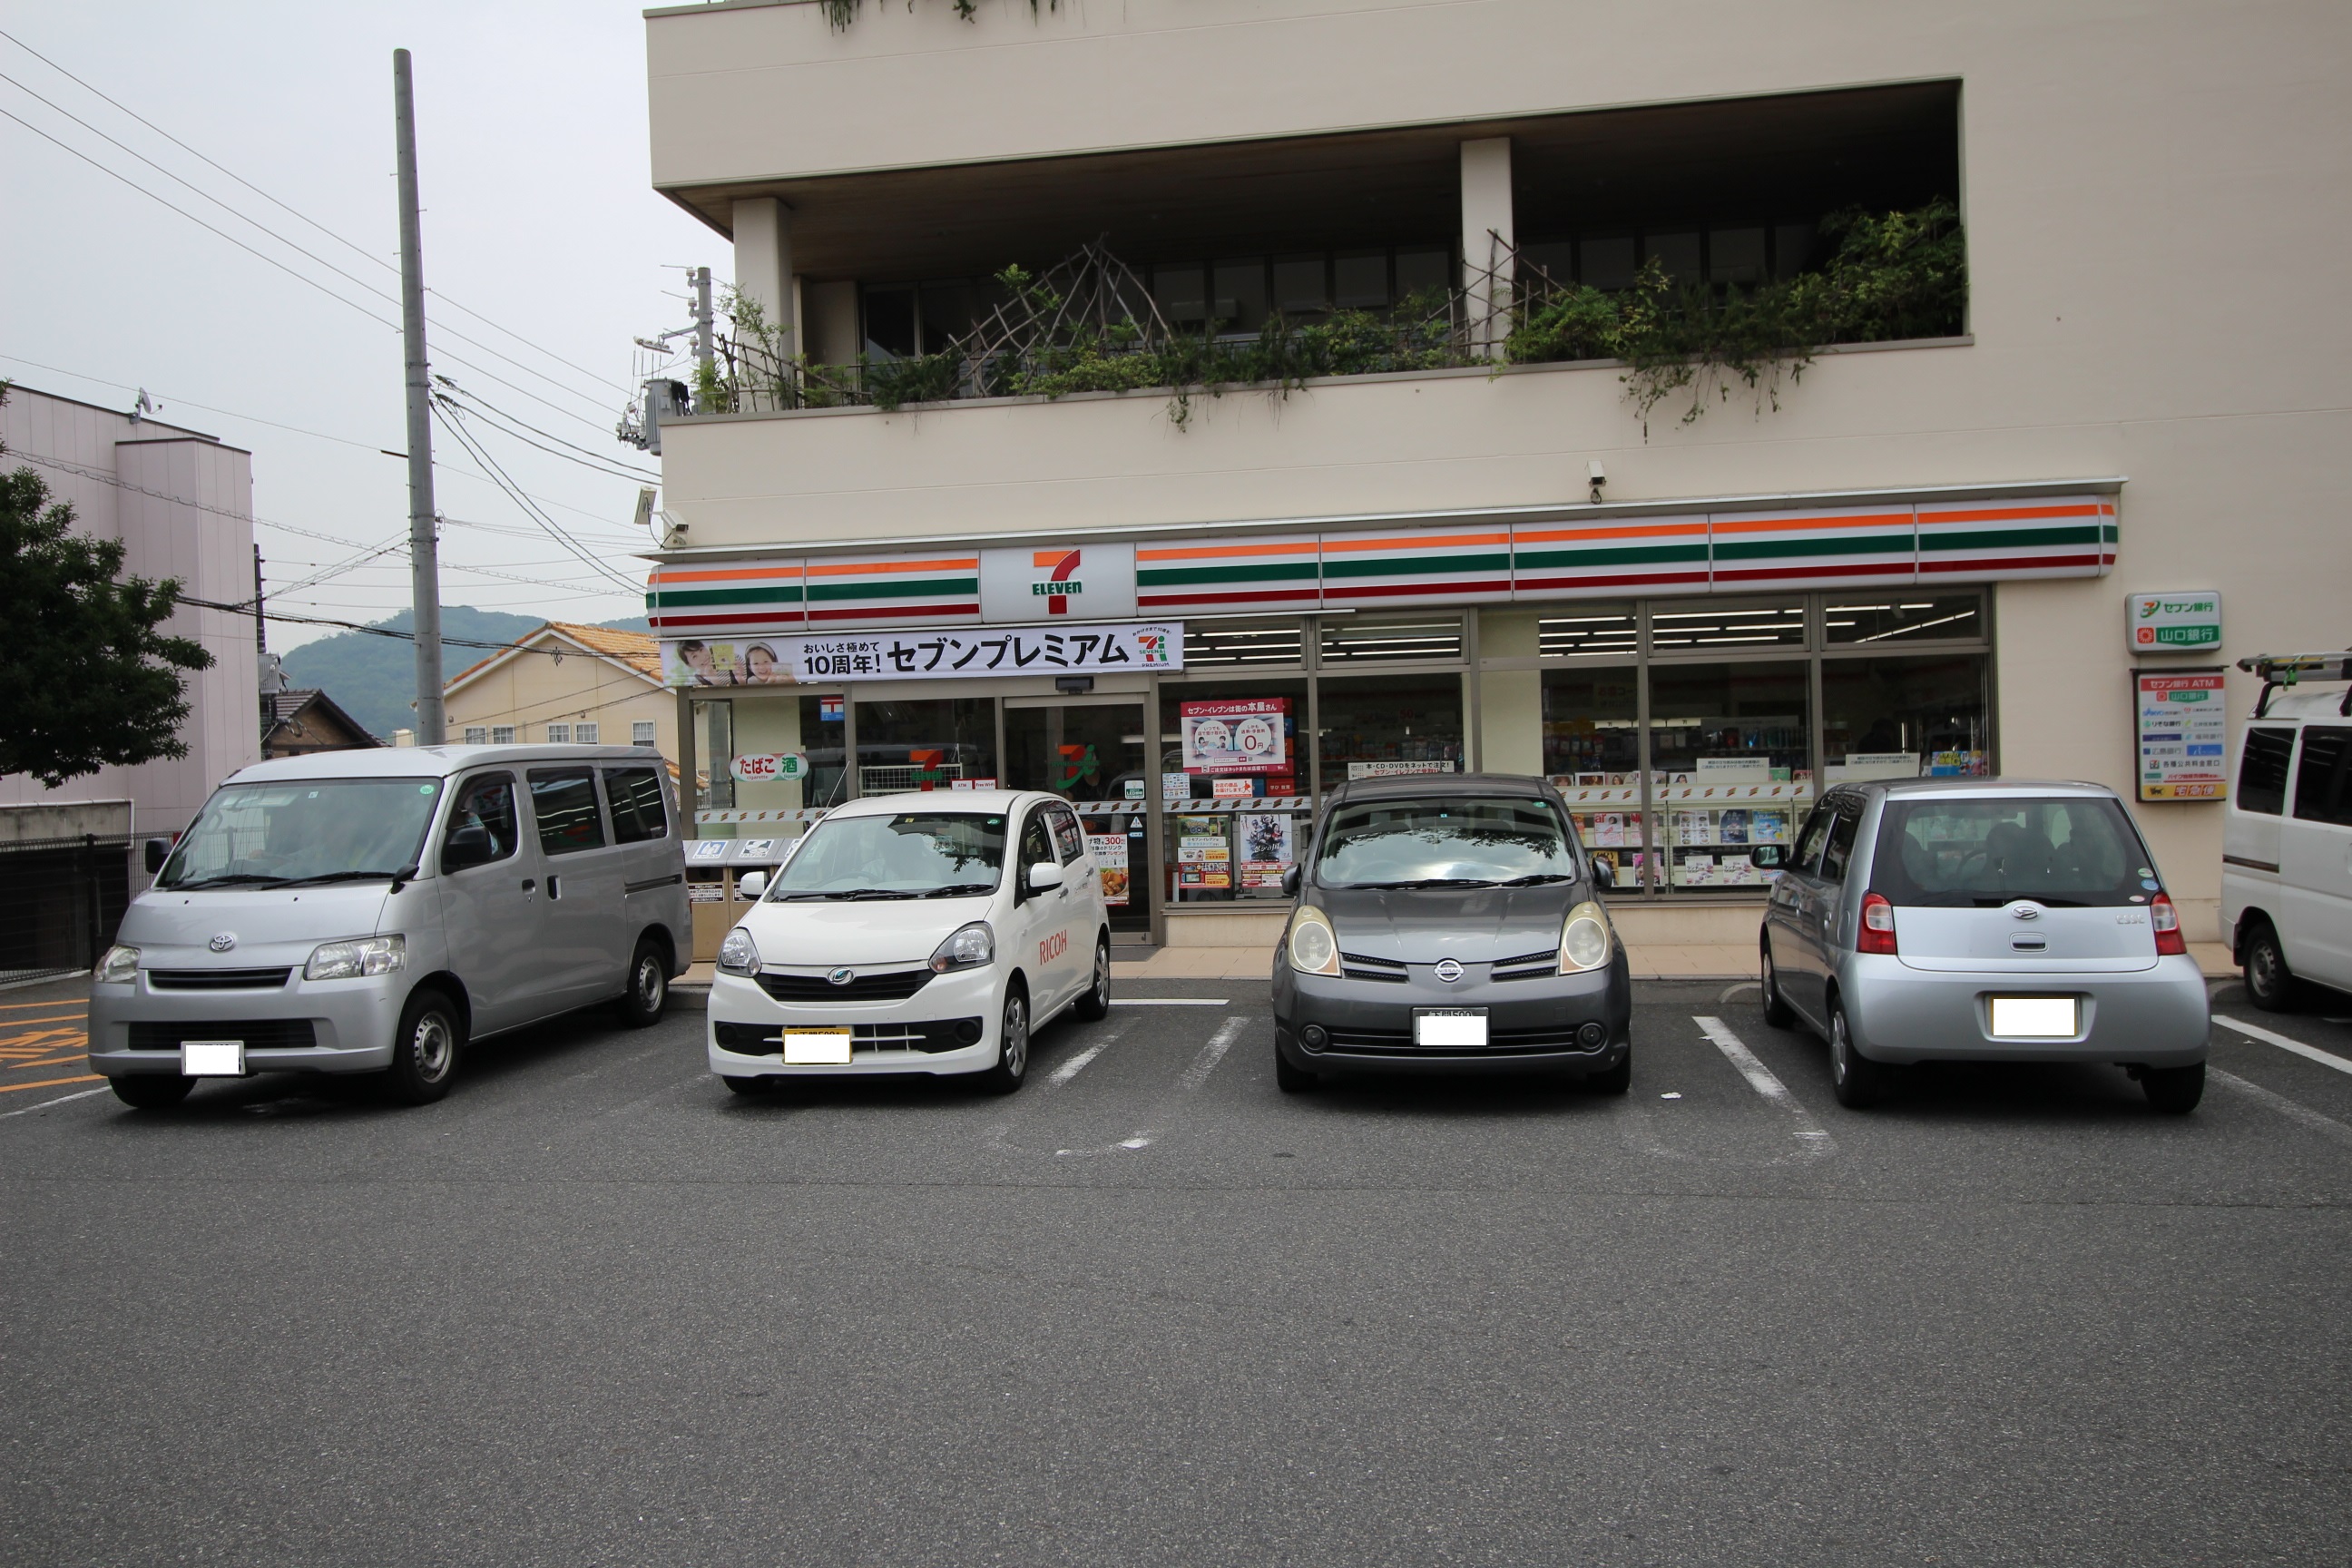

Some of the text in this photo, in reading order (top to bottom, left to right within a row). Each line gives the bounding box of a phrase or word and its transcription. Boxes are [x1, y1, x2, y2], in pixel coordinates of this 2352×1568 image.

[2164, 603, 2213, 613] セブン銀行
[2161, 629, 2214, 642] 山口銀行
[803, 642, 880, 654] おいしさ極めて
[887, 633, 1130, 673] セブンプレミアム
[804, 654, 881, 675] 10周年!
[2150, 679, 2214, 689] セブン銀行 ATM
[2171, 691, 2205, 701] 山口銀行
[740, 758, 776, 775] たばこ
[781, 757, 798, 773] 酒
[2174, 785, 2215, 797] 宅急便
[2116, 914, 2145, 924] ESSE
[1039, 929, 1067, 965] RICOH
